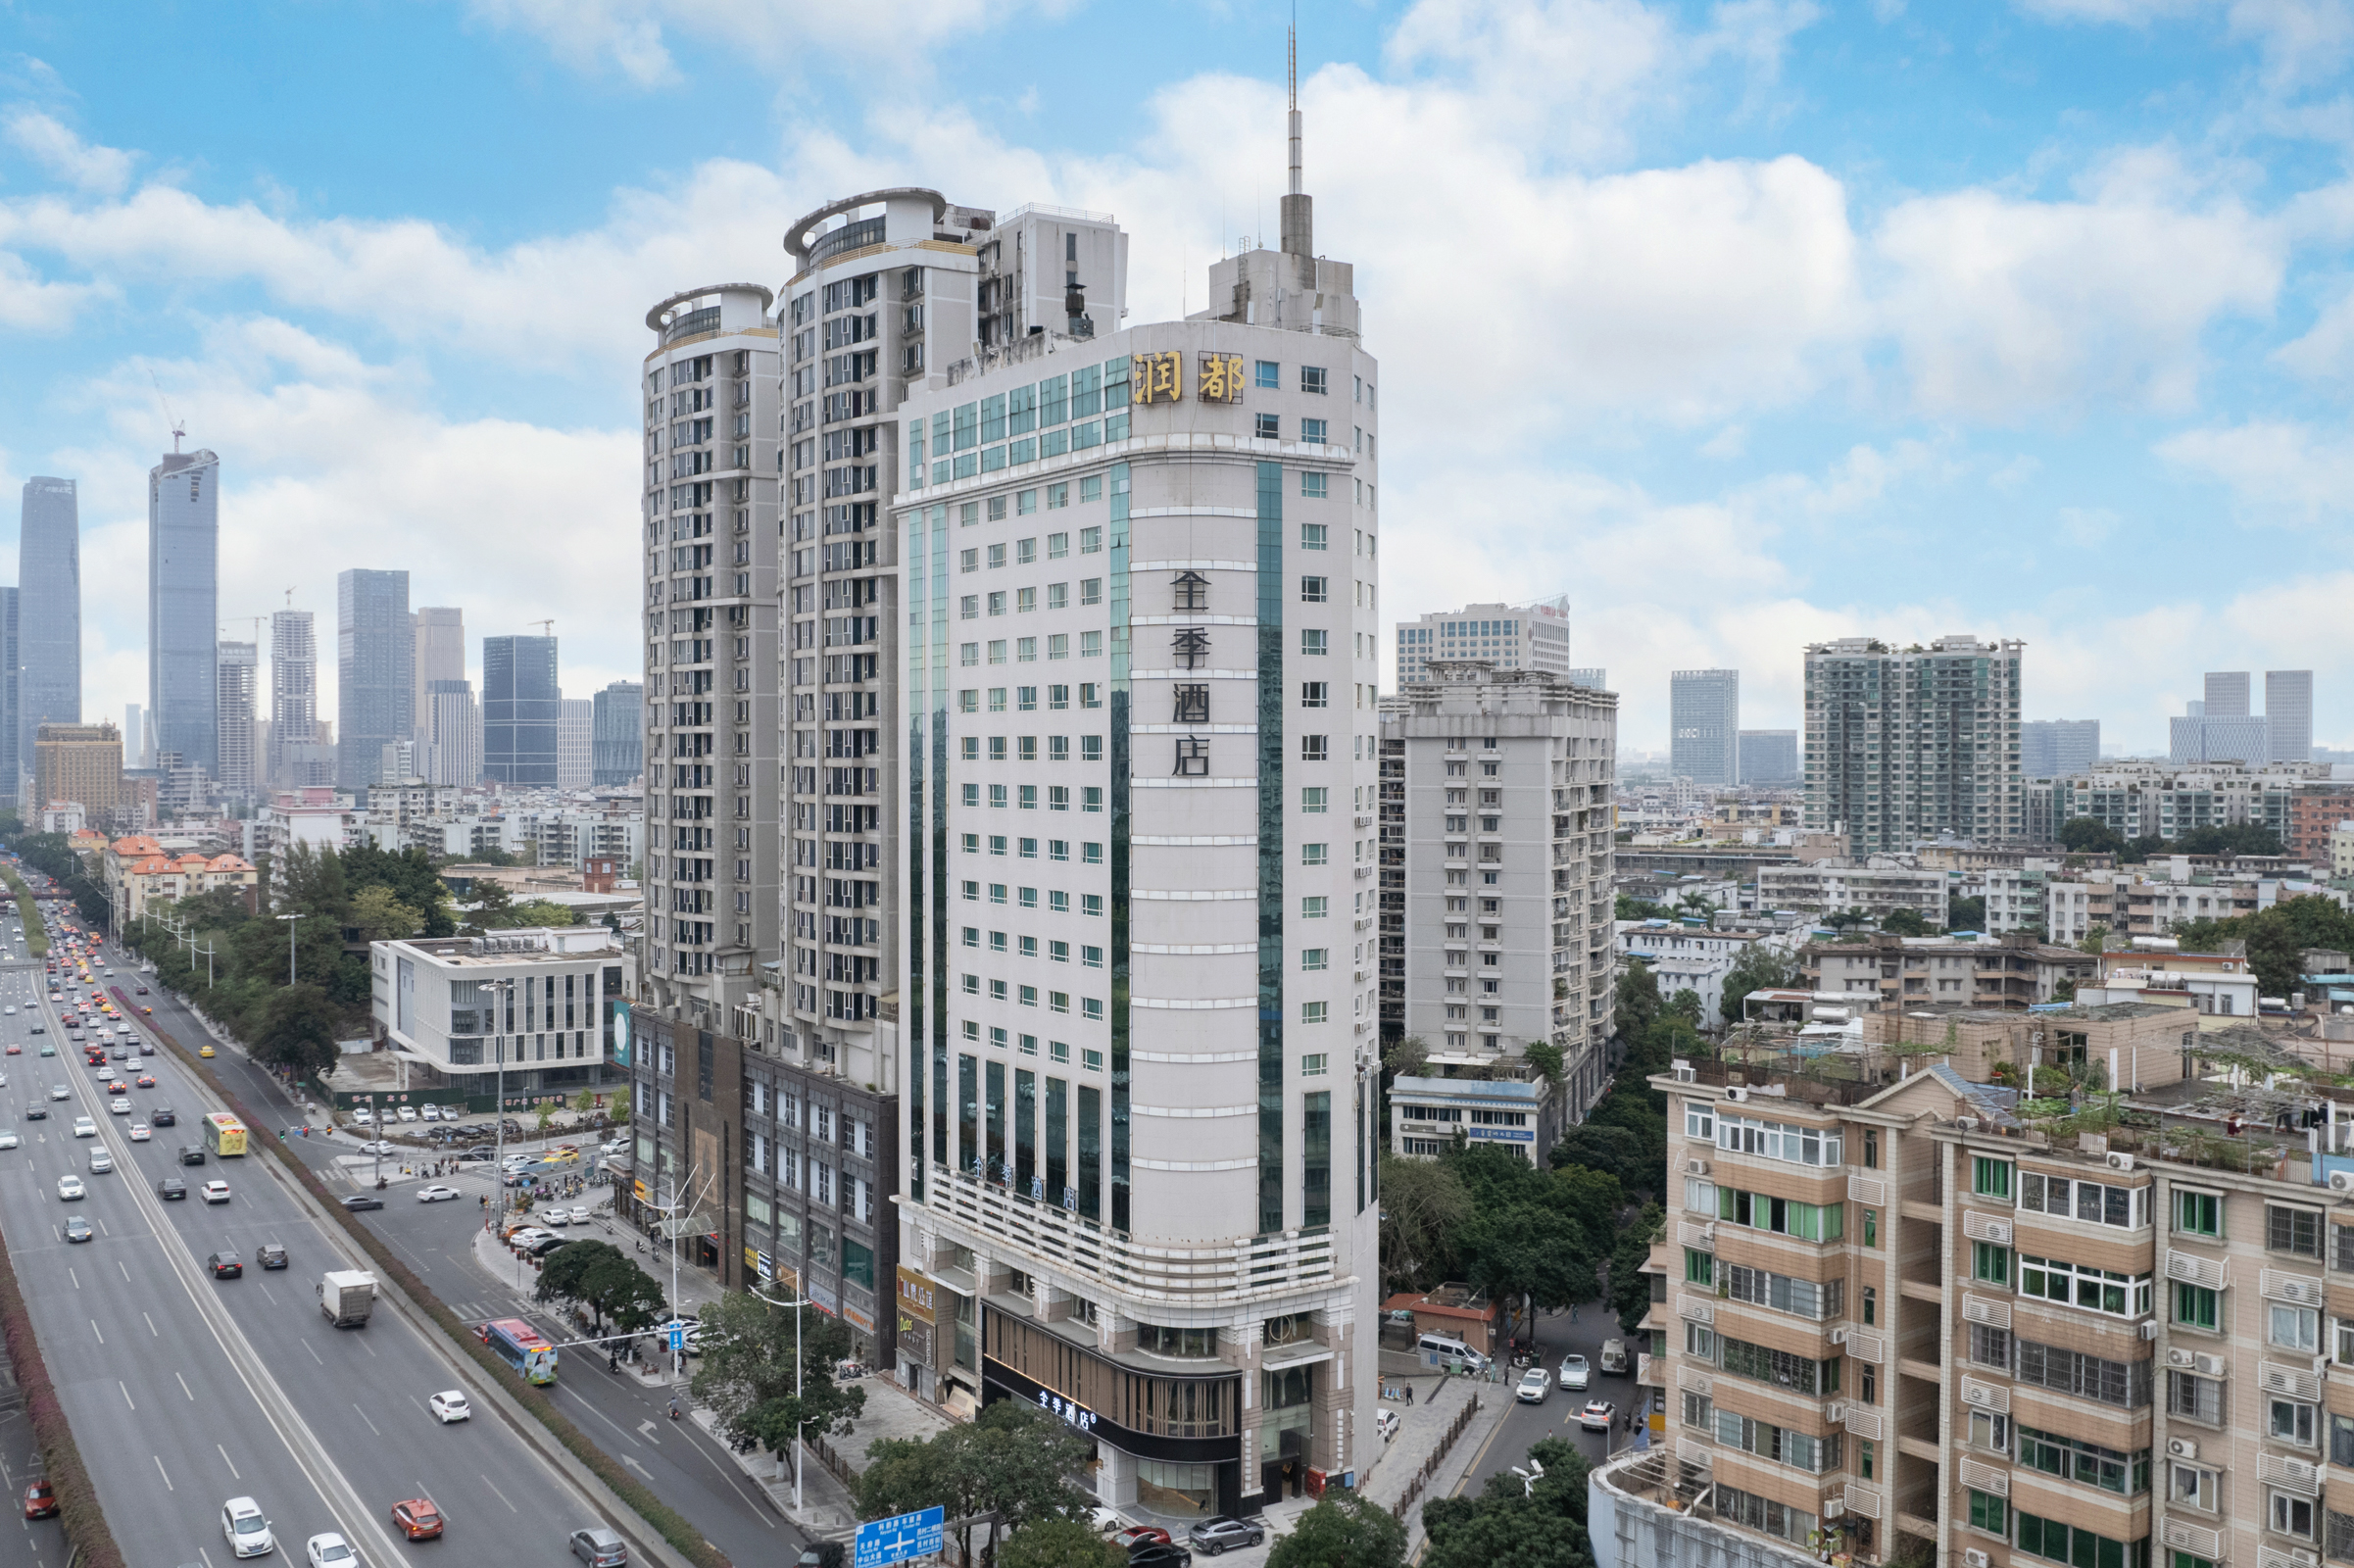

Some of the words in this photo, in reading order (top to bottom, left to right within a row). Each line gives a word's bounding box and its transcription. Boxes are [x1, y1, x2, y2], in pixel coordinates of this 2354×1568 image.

[1135, 351, 1246, 404] 润都
[1170, 570, 1211, 776] 全季酒店
[973, 1156, 1076, 1211] 全季酒店
[1039, 1391, 1089, 1431] 全季酒店
[858, 1550, 882, 1564] 中山大道
